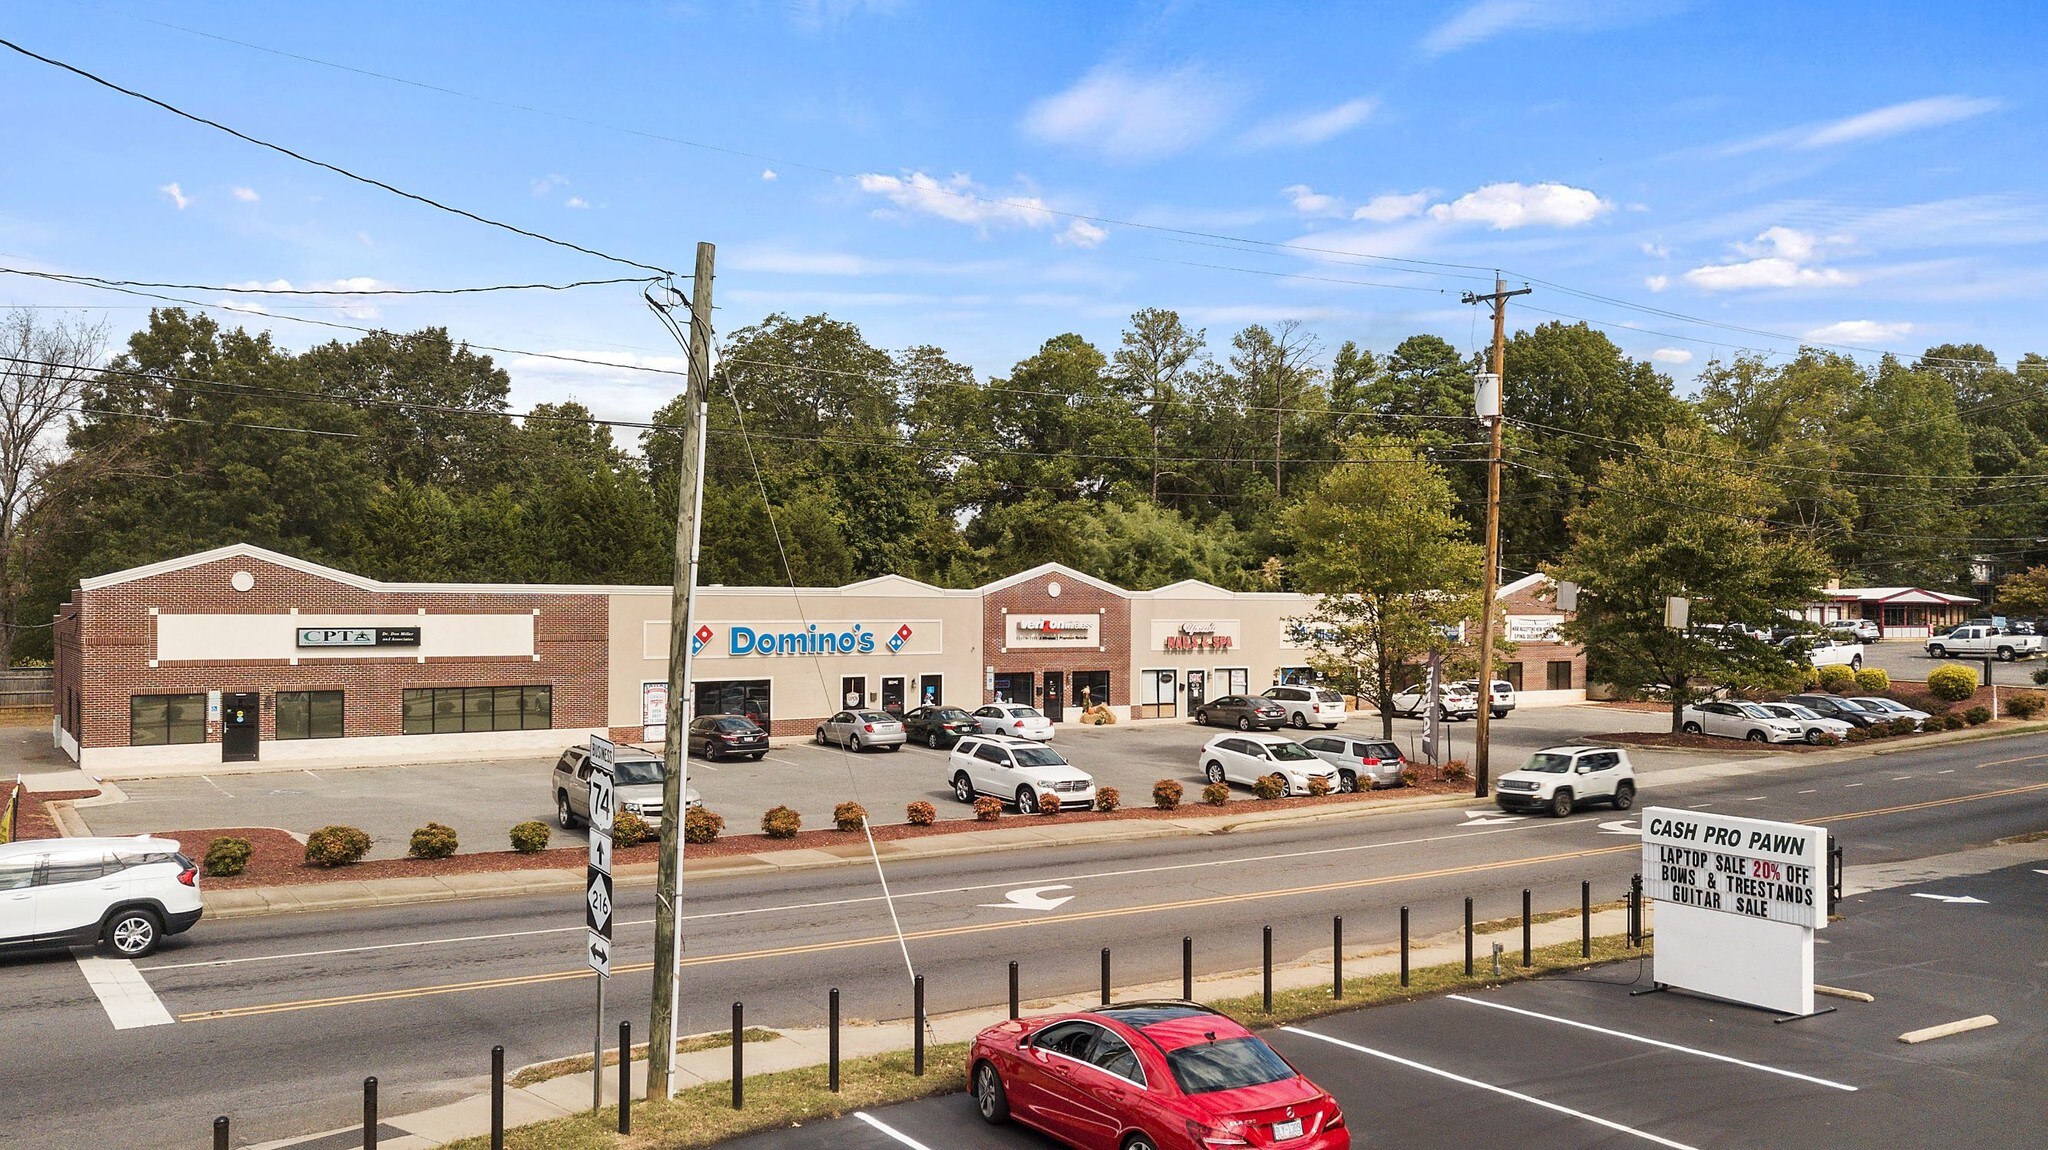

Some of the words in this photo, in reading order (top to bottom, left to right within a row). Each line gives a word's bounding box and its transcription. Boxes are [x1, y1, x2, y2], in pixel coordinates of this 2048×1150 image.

[729, 623, 875, 656] Domino's
[1167, 636, 1199, 649] NAILS
[1201, 636, 1209, 648] &
[1212, 636, 1233, 648] SPA
[592, 743, 612, 764] BUSINESS
[592, 781, 610, 820] 74
[1650, 818, 1698, 840] CASH
[1703, 826, 1742, 847] PRO
[1748, 831, 1805, 856] PAWN
[1660, 846, 1708, 868] LAPTOP
[1716, 855, 1746, 875] SALE
[1753, 860, 1781, 881] 20%
[1786, 865, 1809, 886] OFF
[593, 890, 608, 915] 216
[1662, 865, 1696, 886] BOWS
[1707, 872, 1716, 890] &
[1726, 875, 1813, 907] TREESTANDS
[1673, 885, 1721, 909] GUITAR
[1736, 897, 1768, 918] SALE
